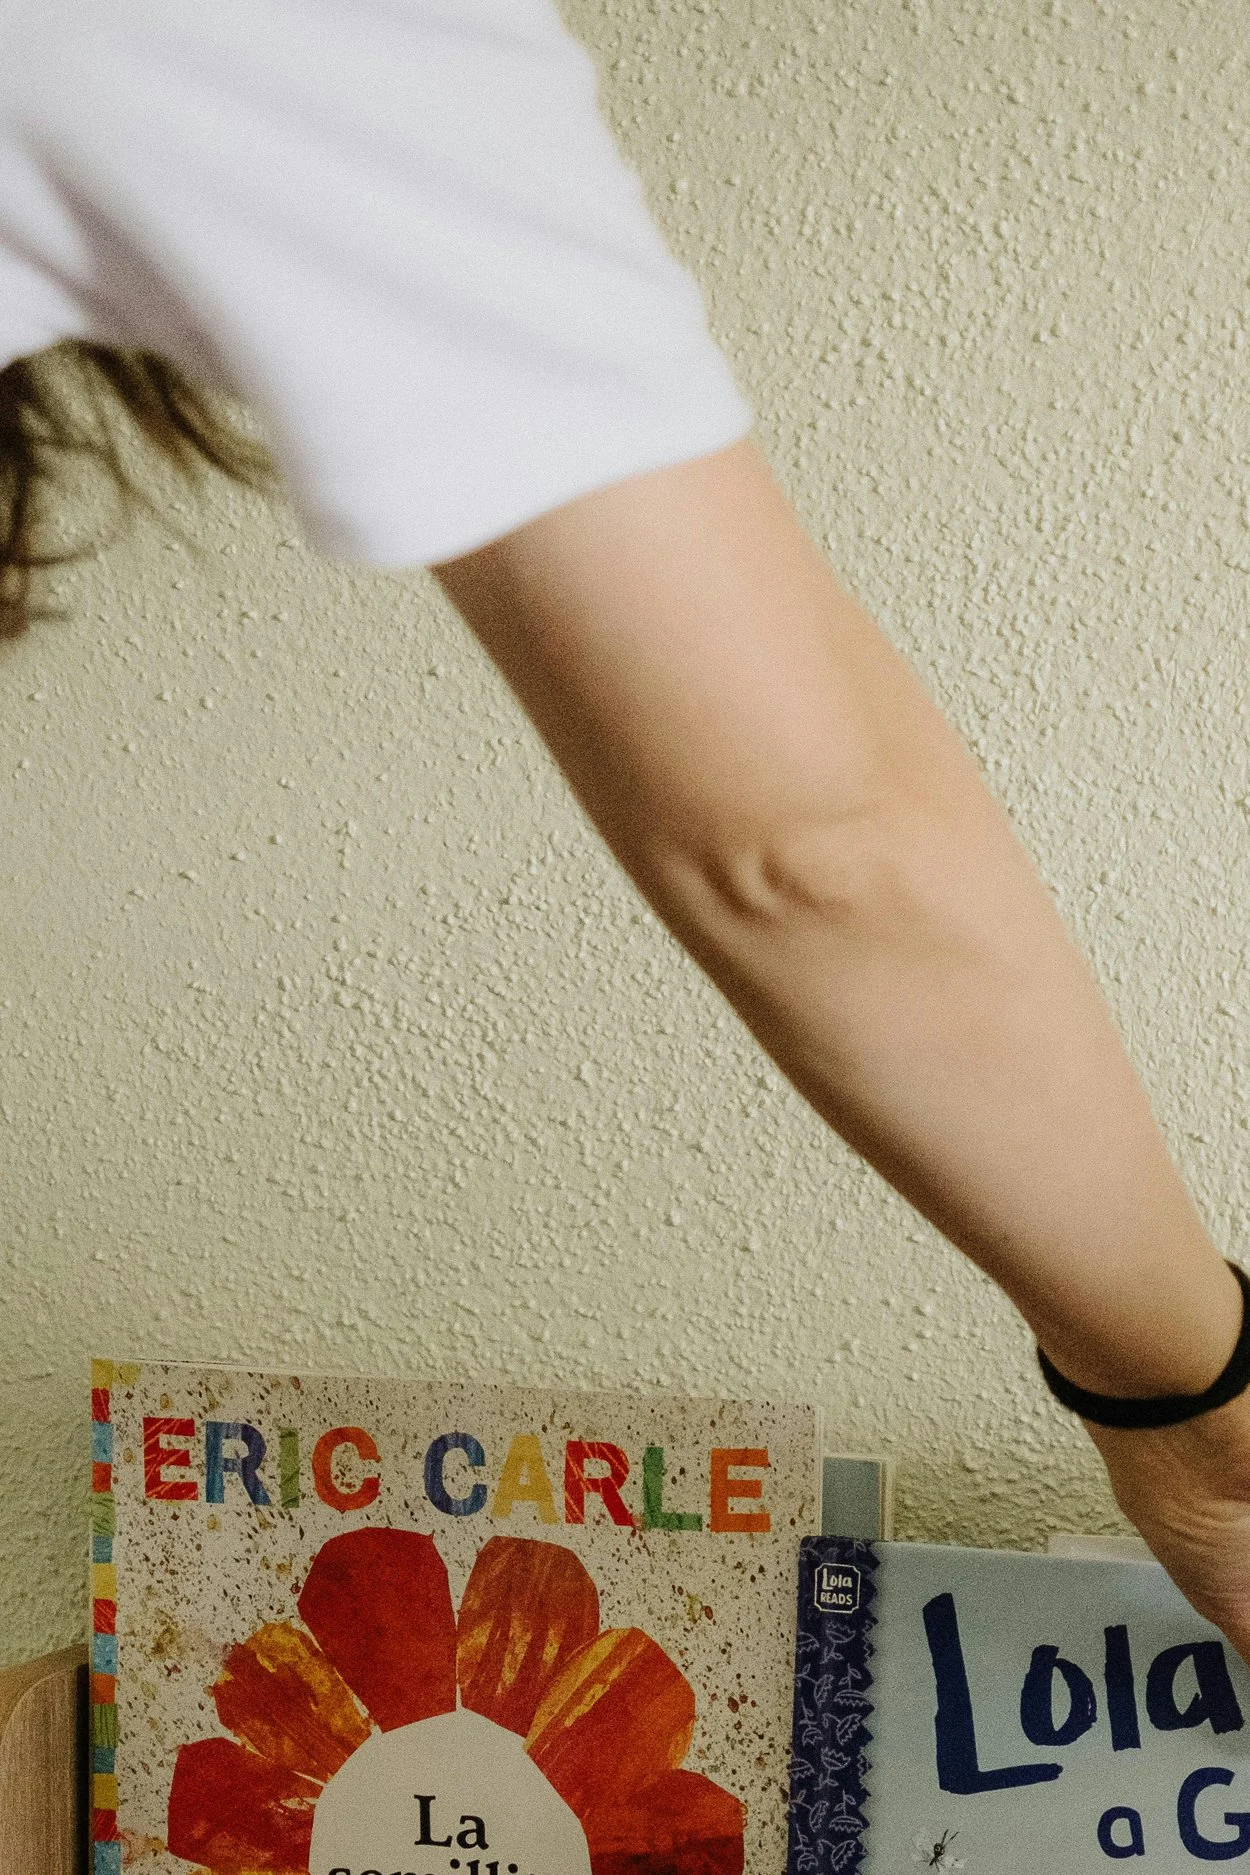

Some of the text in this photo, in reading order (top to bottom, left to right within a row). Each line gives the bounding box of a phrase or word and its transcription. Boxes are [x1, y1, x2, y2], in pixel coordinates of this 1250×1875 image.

[142, 1416, 773, 1534] ERIC CARLE
[819, 1591, 854, 1606] READS
[821, 1567, 853, 1591] Lola
[922, 1592, 1246, 1795] Lola
[413, 1793, 490, 1851] La
[1097, 1803, 1146, 1860] a
